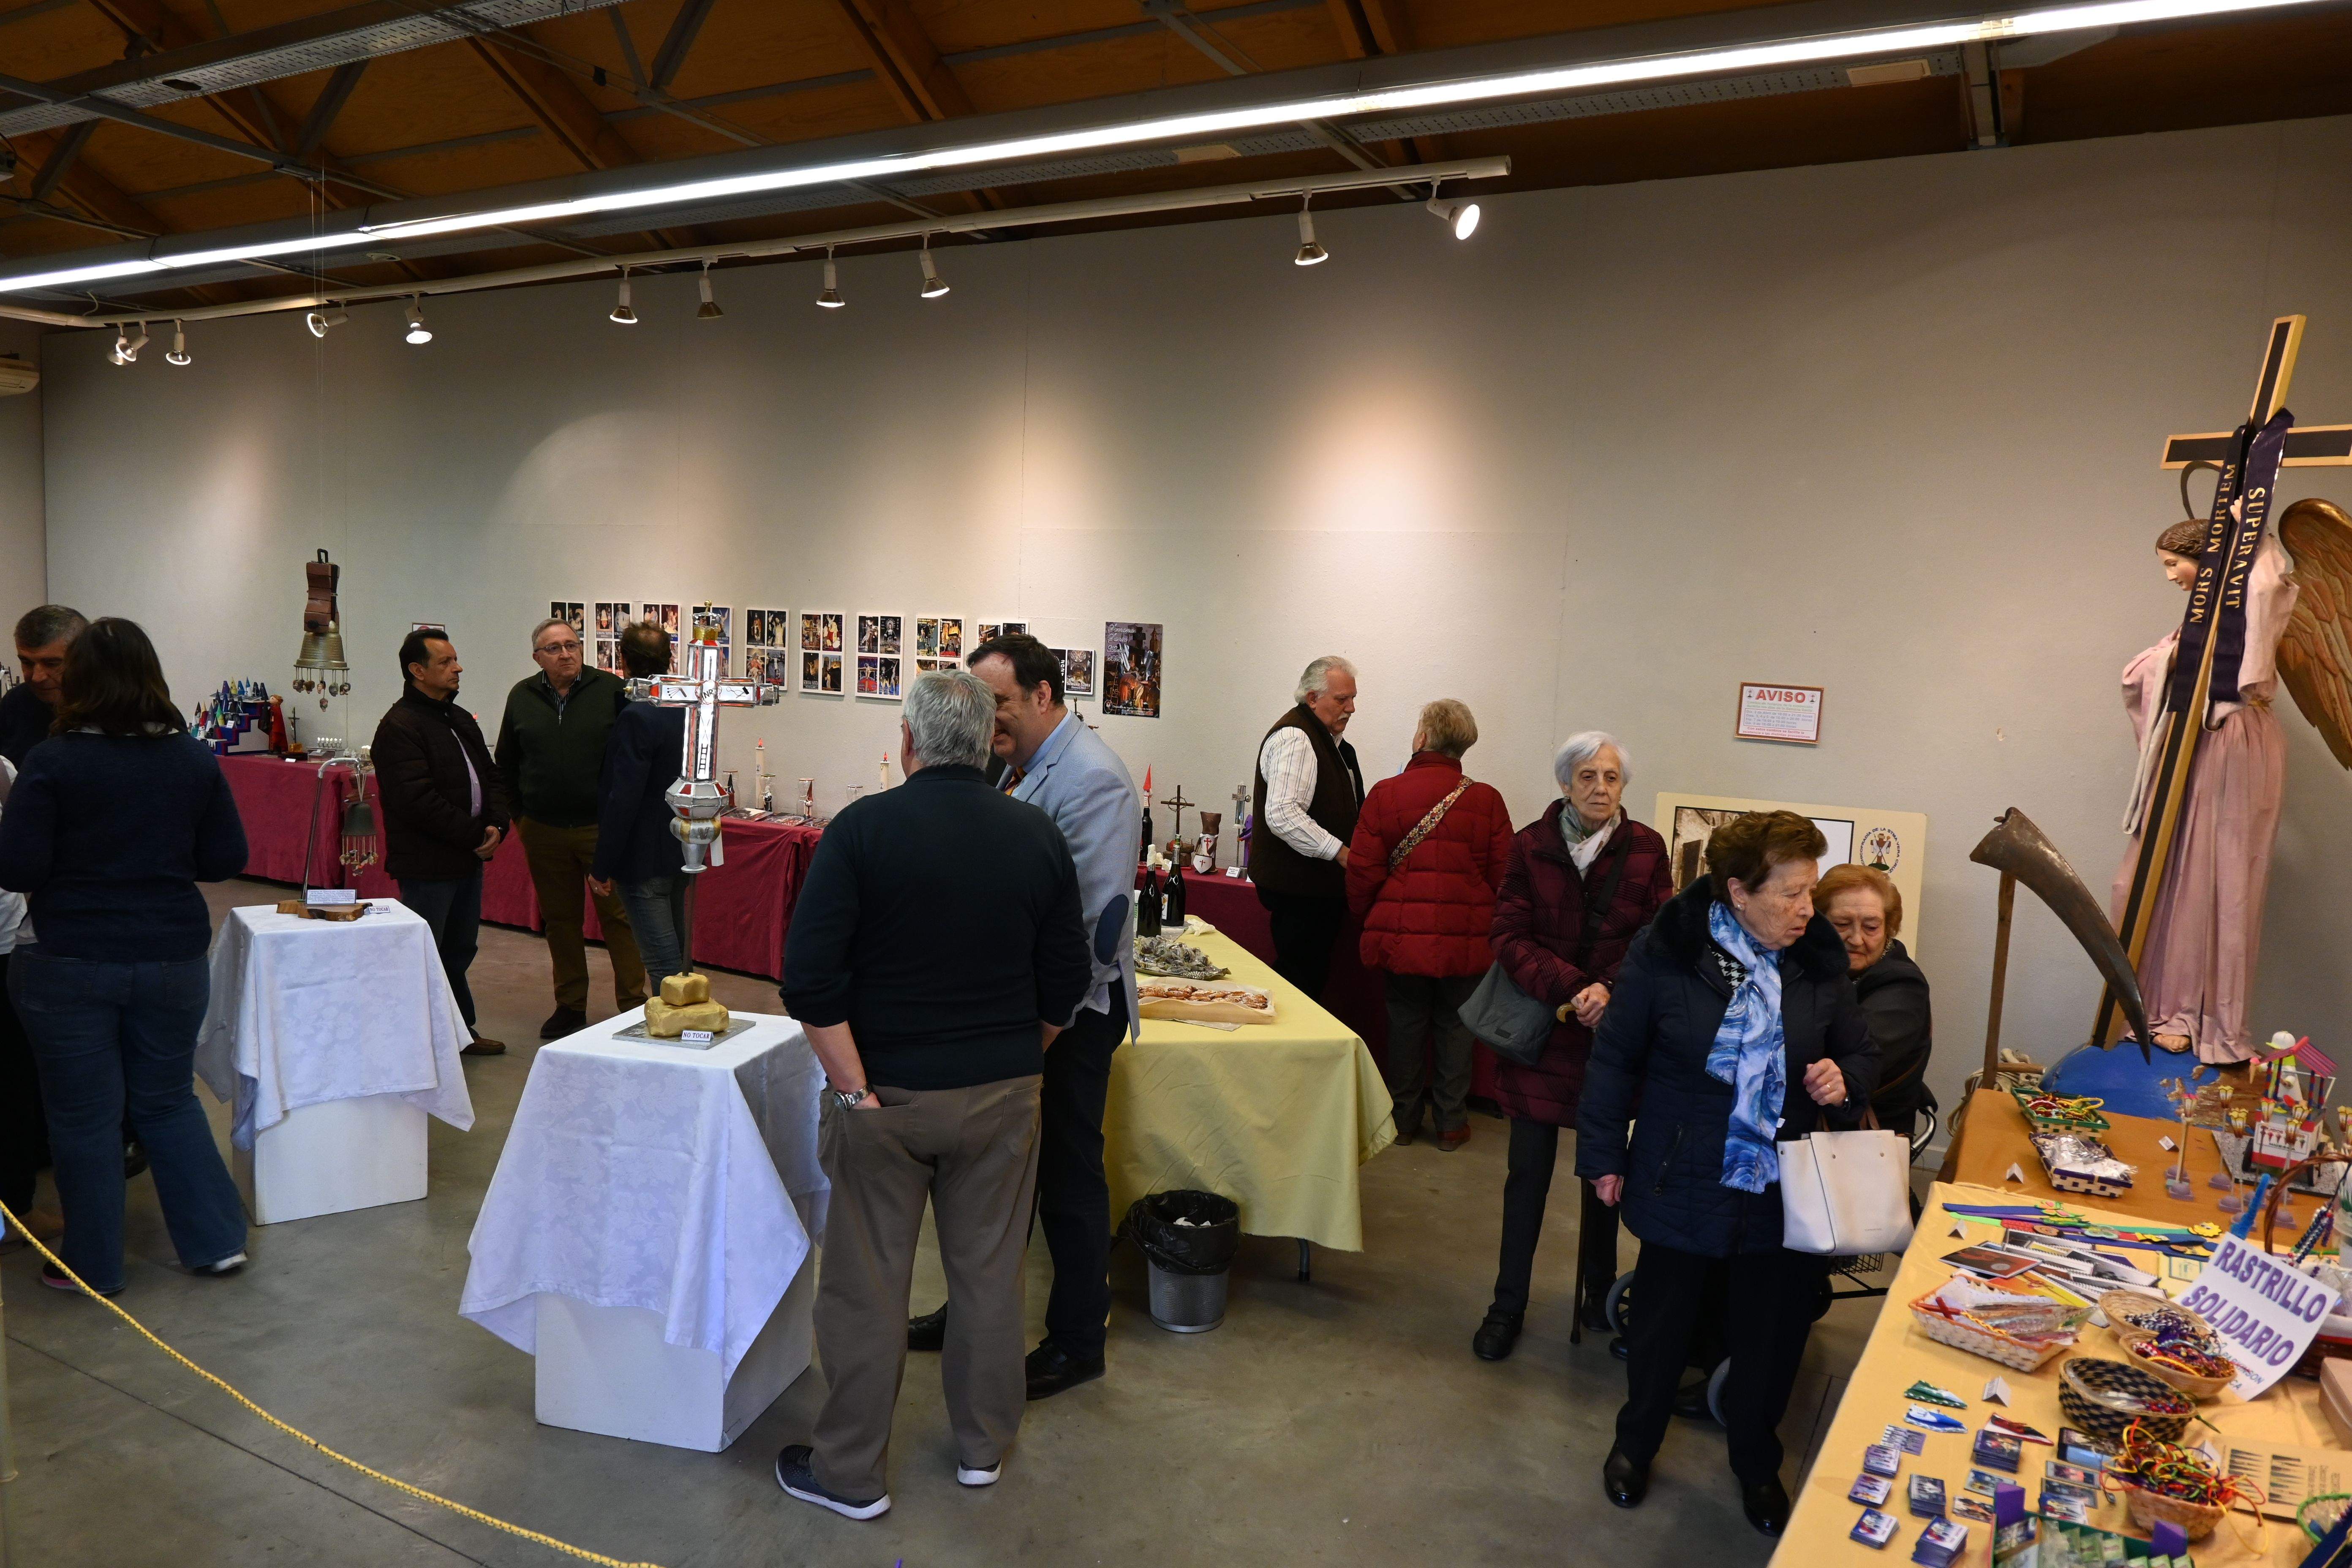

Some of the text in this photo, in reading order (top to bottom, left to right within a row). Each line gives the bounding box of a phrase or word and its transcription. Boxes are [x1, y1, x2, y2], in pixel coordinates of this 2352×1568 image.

[2190, 464, 2236, 623] MORS MORTEM
[2226, 487, 2266, 609] SUPERAVIT
[1755, 689, 1806, 703] AVISO
[1859, 831, 1872, 866] CHICOFRADÍA
[1889, 859, 1899, 874] CRUZ
[2213, 1241, 2327, 1323] RASTRILLO
[2181, 1285, 2295, 1367] SOLIDARIO
